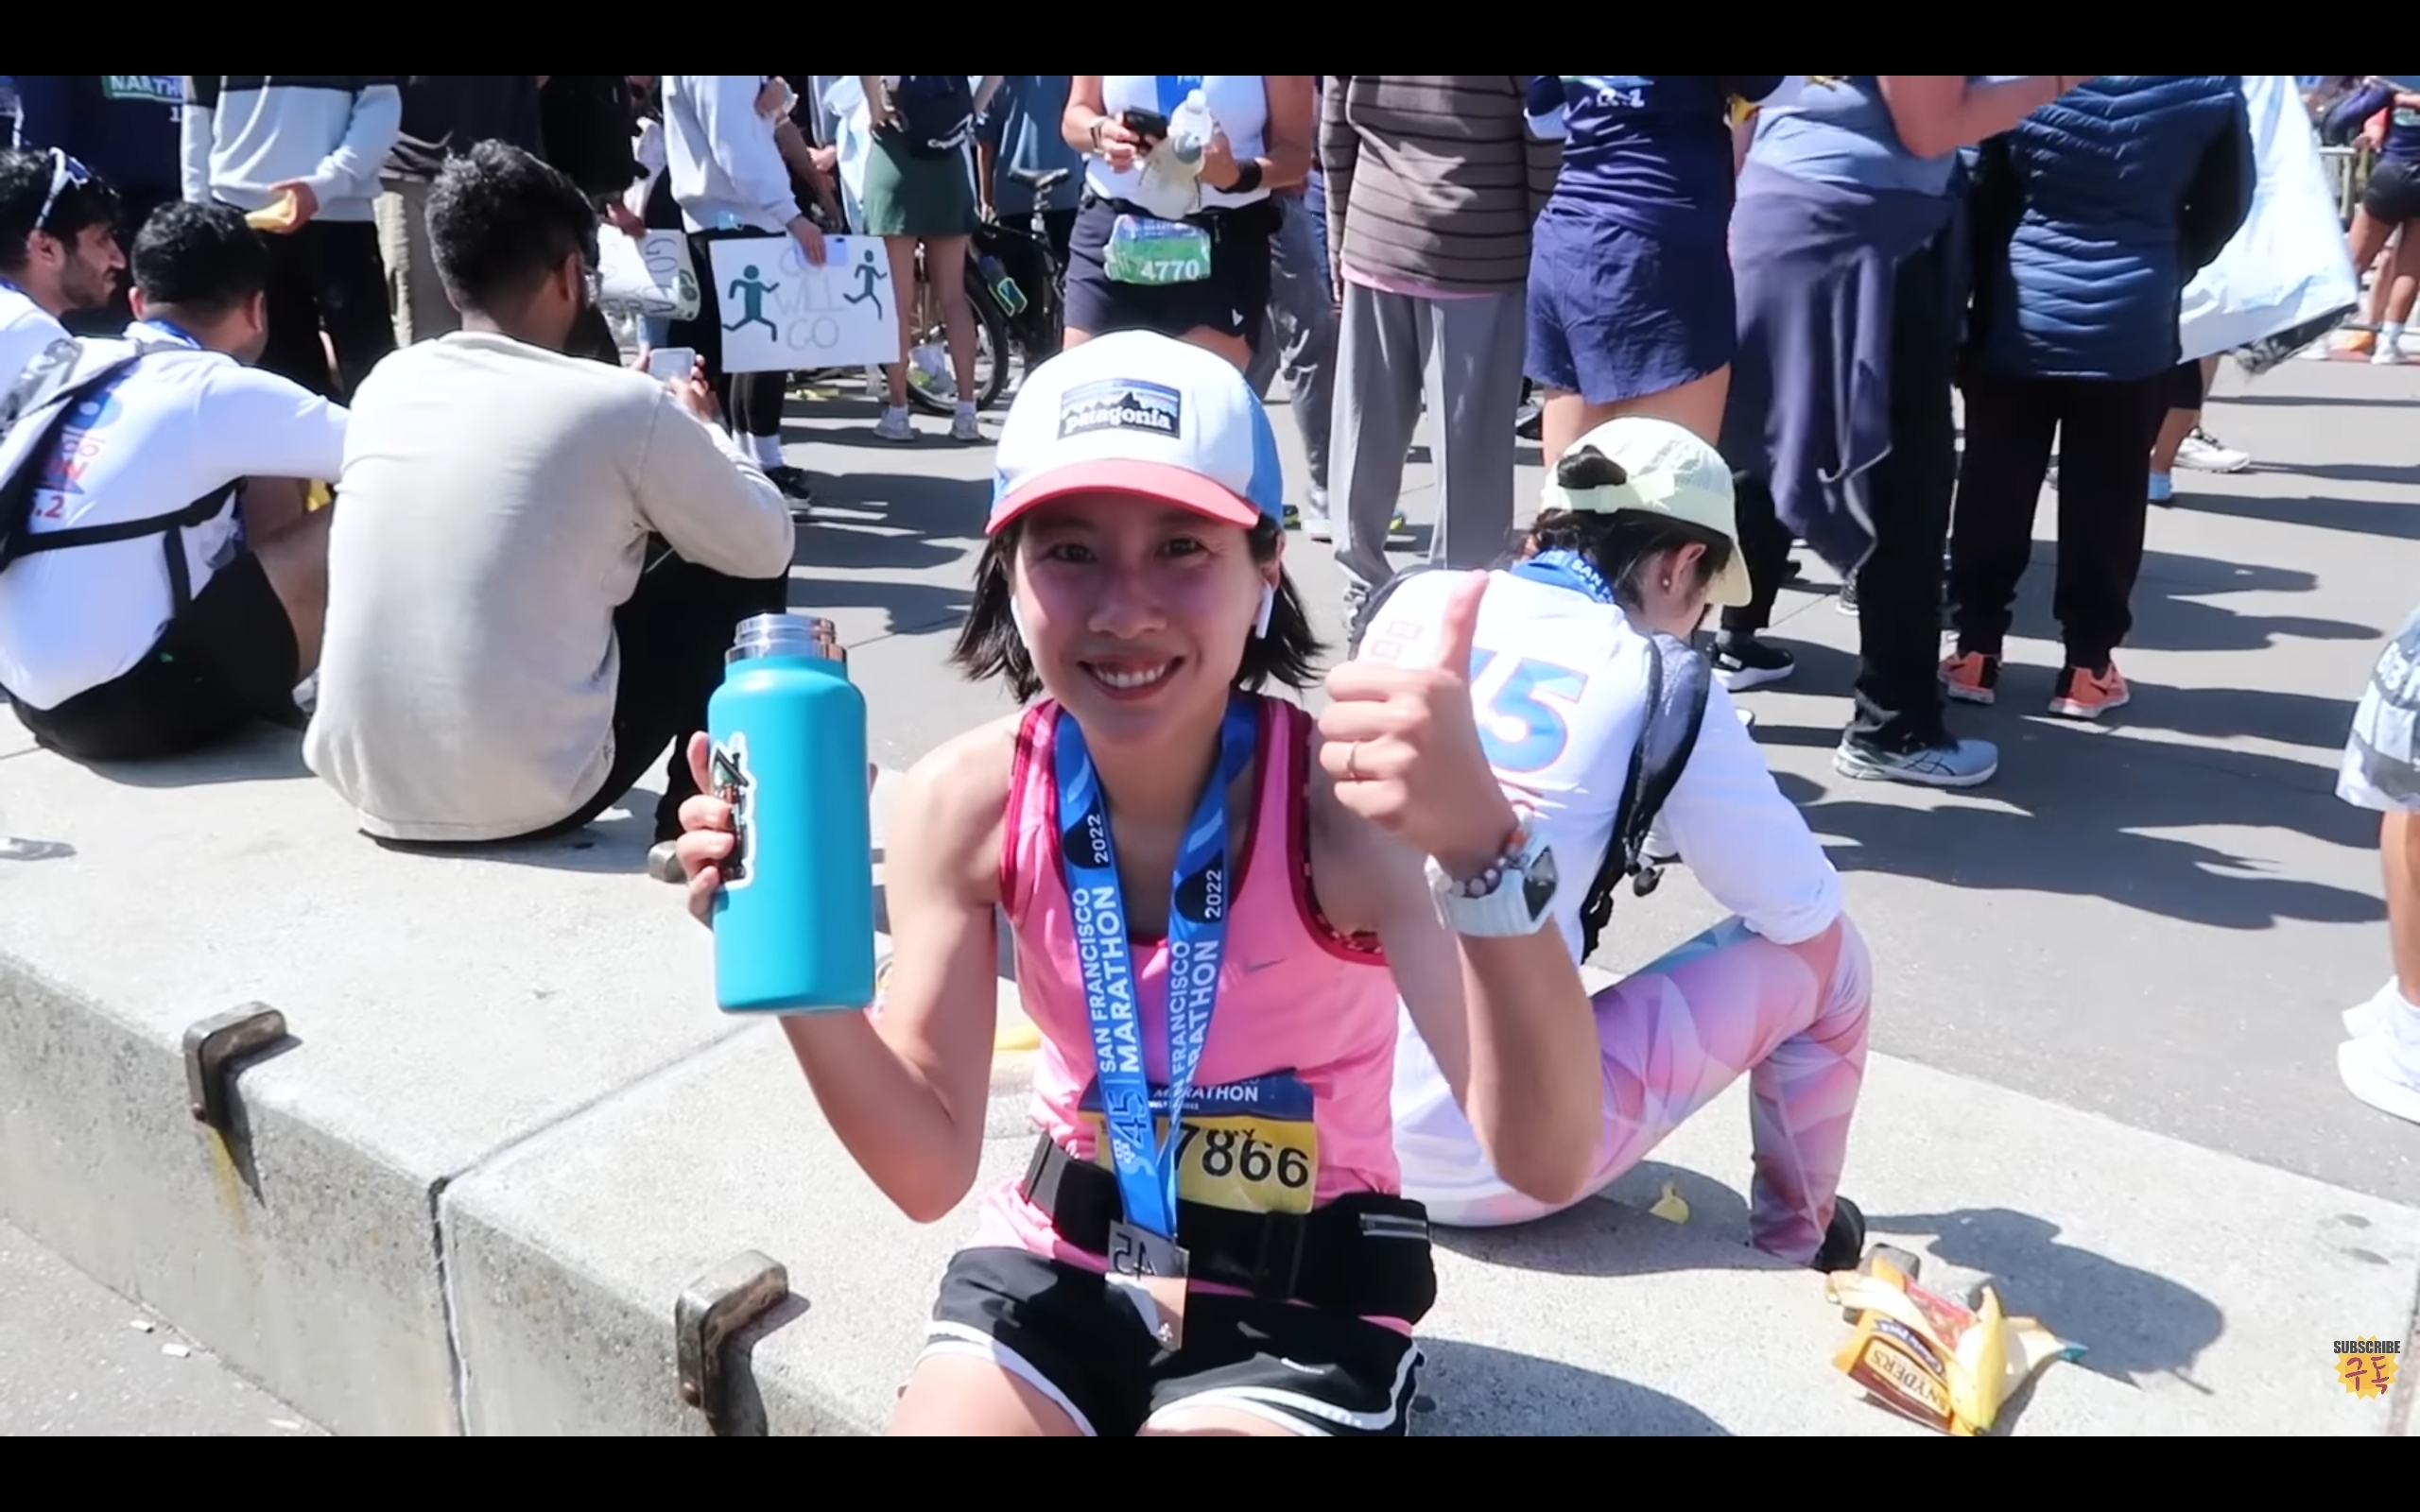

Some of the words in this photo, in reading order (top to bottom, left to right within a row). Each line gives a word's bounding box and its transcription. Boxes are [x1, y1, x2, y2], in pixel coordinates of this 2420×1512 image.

[786, 316, 839, 352] GO
[1087, 814, 1109, 864] 2022
[1203, 869, 1222, 919] 2022
[1071, 887, 1109, 1022] FRANCISCO
[1091, 885, 1141, 1073] MARATHON
[1169, 940, 1191, 1075] FRANCISCO
[1185, 939, 1219, 1083] RATHON
[1093, 1027, 1117, 1074] SAN
[1106, 1089, 1149, 1151] 45
